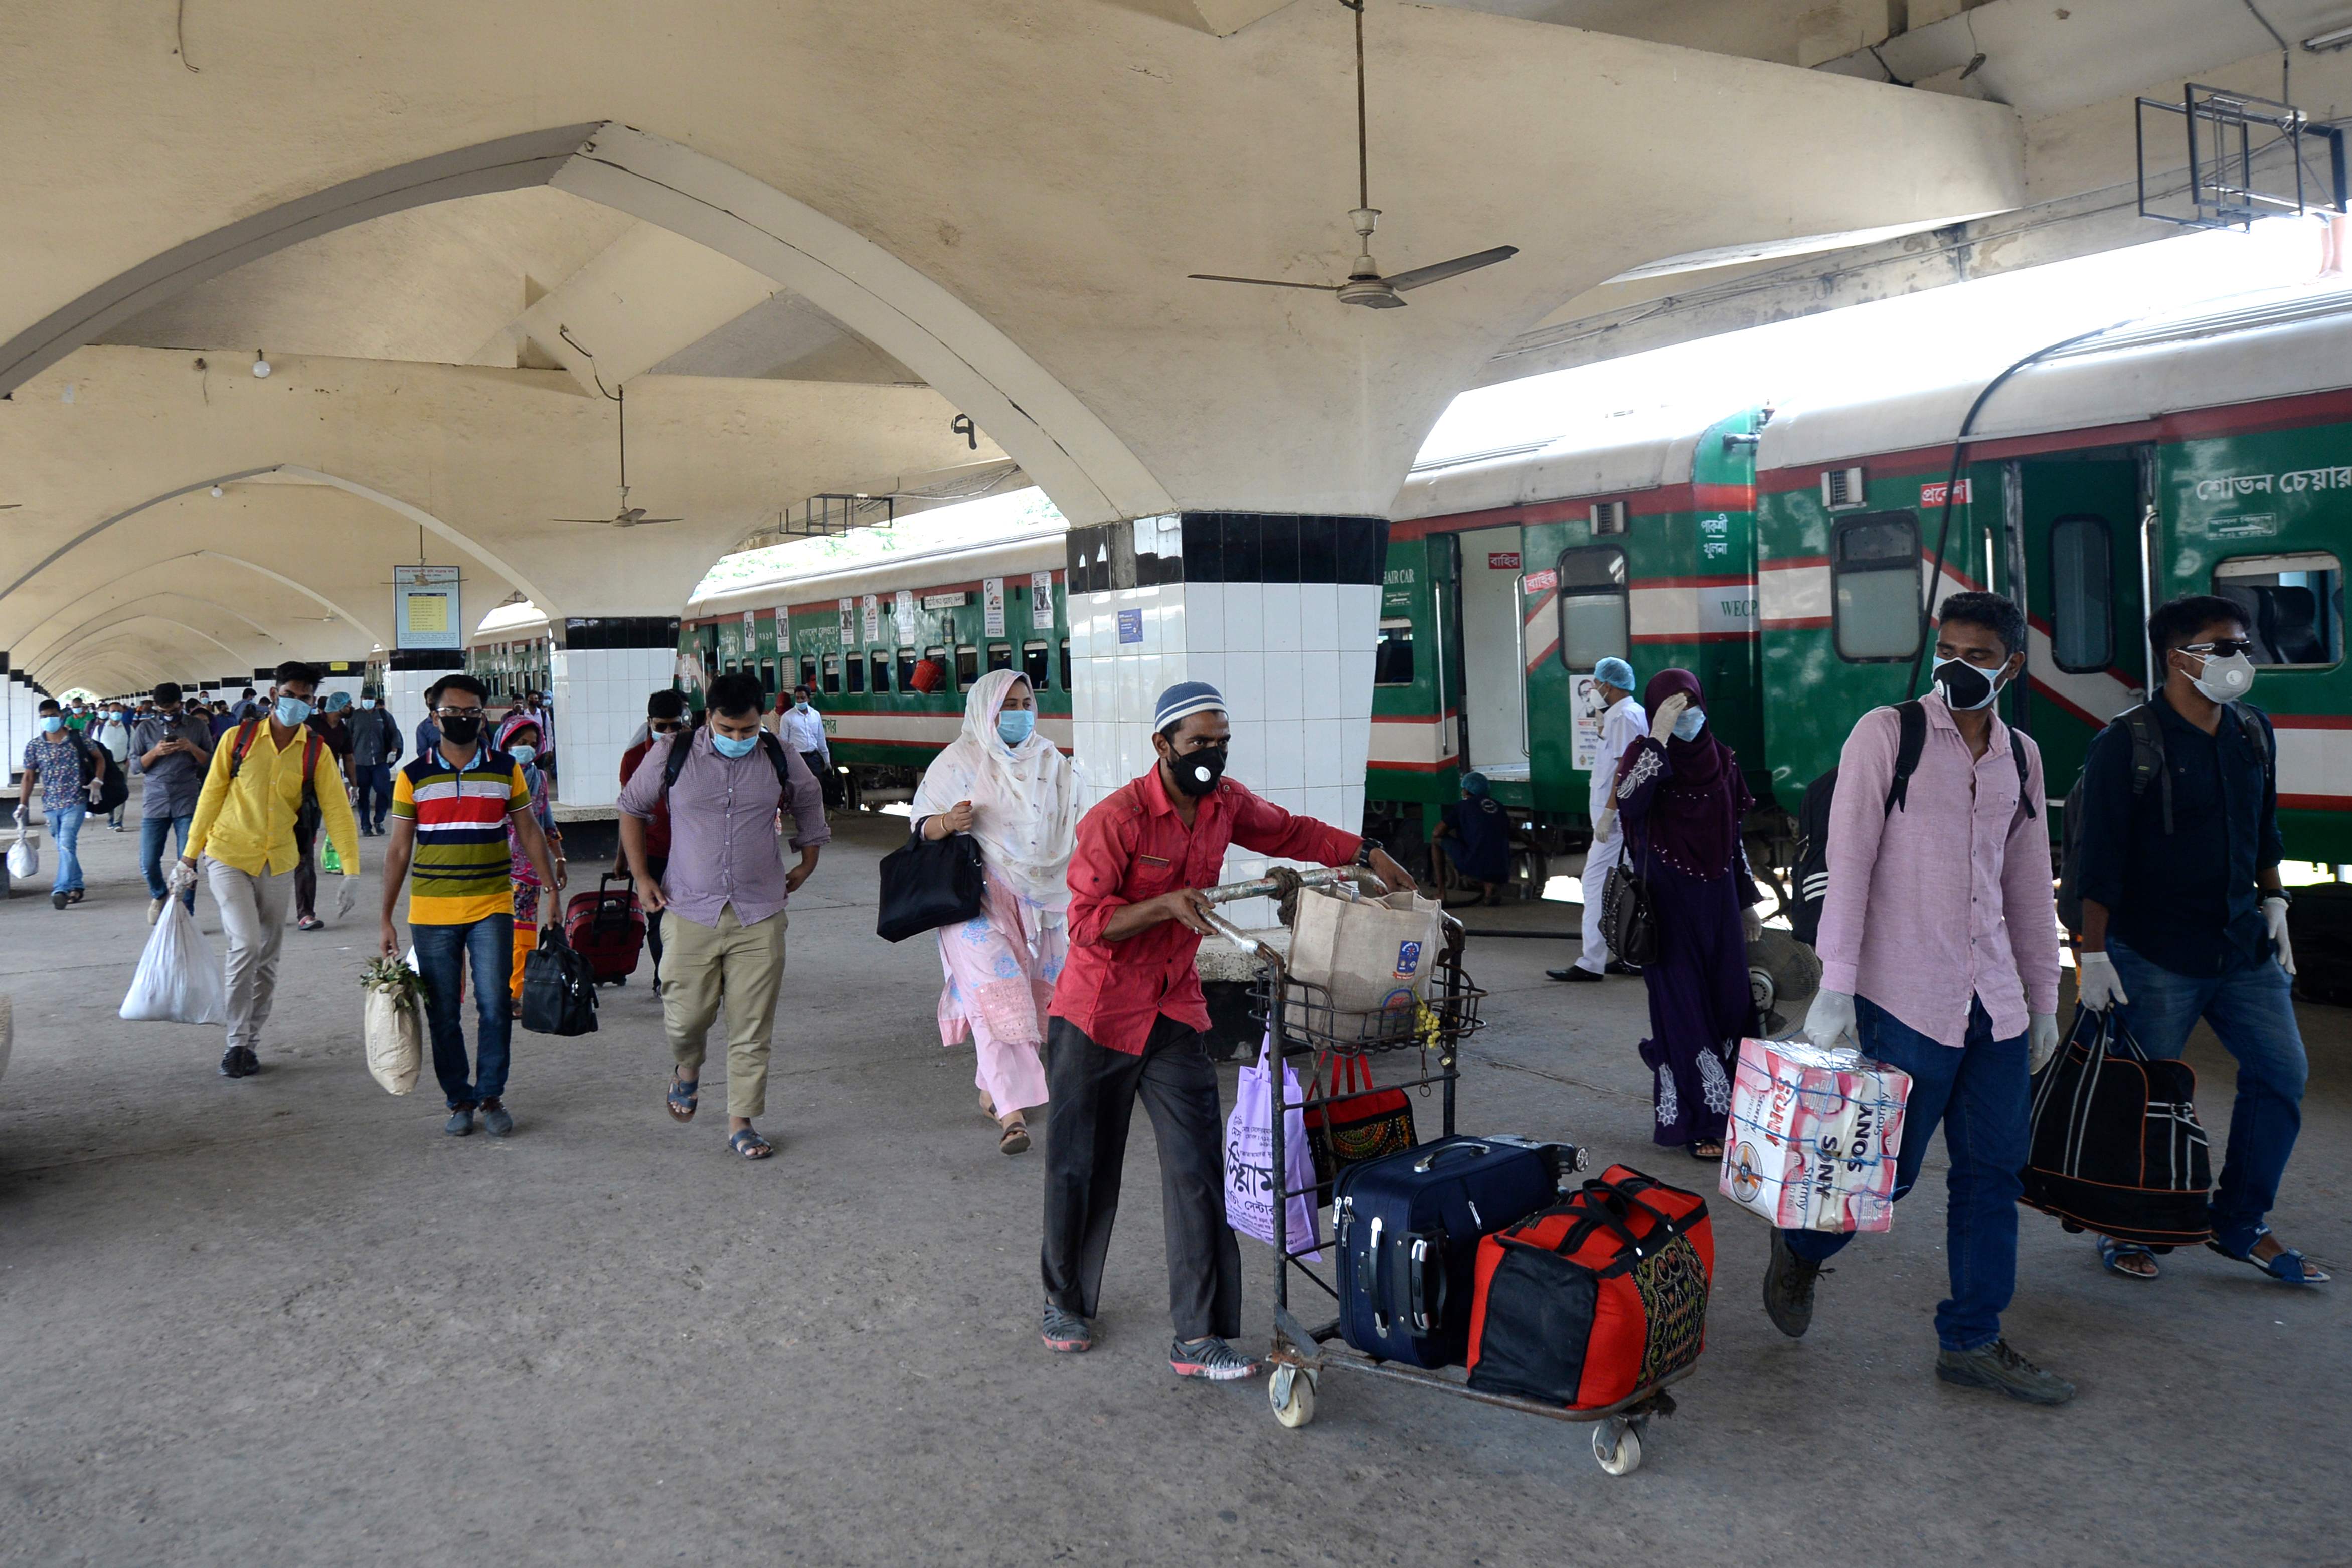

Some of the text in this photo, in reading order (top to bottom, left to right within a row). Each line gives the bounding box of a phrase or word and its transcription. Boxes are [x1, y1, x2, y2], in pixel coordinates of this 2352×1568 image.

[2197, 474, 2274, 500] শোভন
[1490, 554, 1519, 567] বাহির
[1400, 569, 1414, 583] CAR
[1527, 572, 1556, 587] বাহির
[1847, 1104, 1874, 1172] SONY
